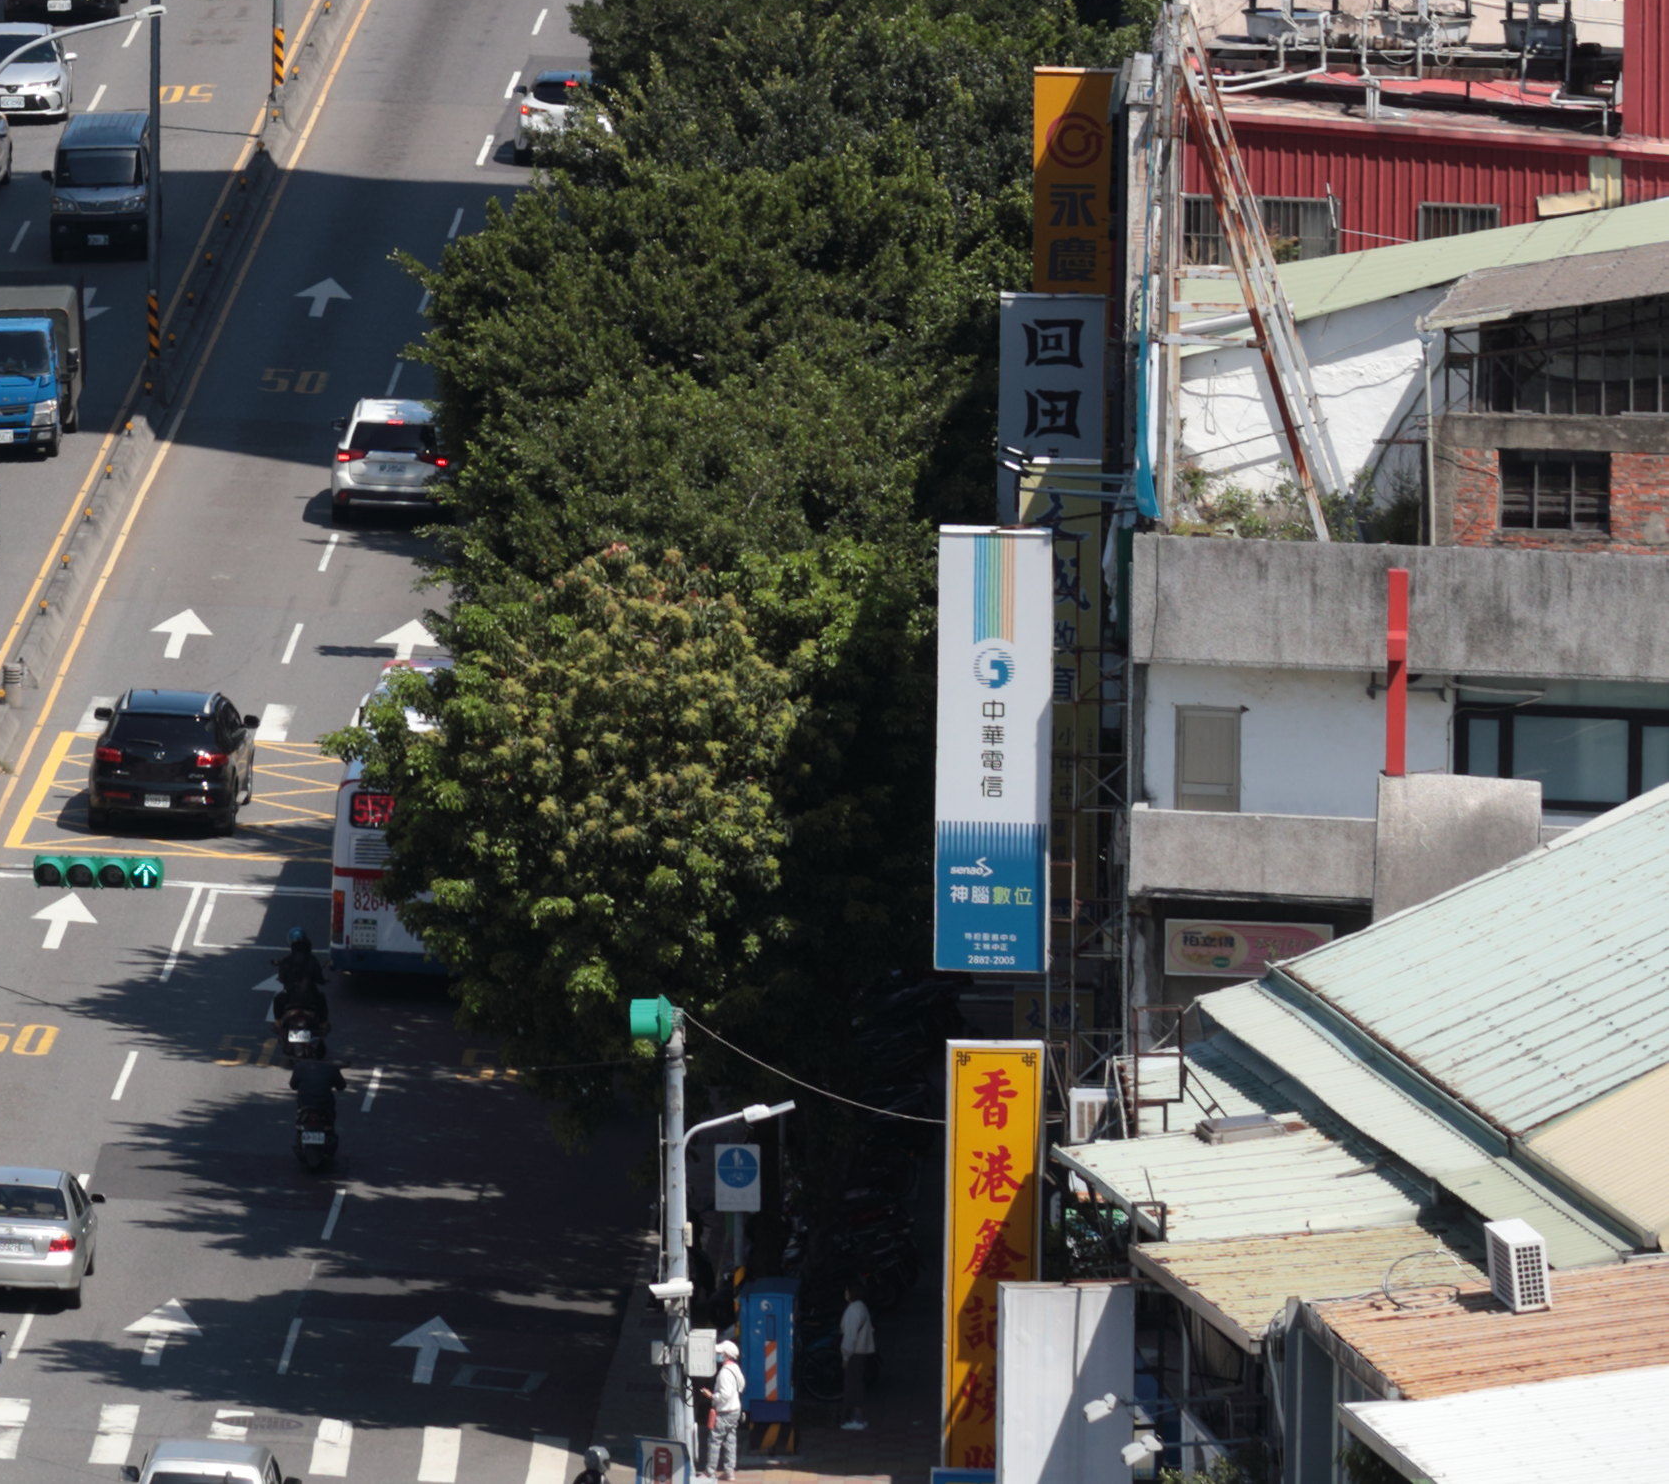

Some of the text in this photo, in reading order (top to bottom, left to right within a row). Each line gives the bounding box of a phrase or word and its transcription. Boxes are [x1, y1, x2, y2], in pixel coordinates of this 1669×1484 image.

[1049, 183, 1097, 282] 永慶
[981, 699, 1006, 800] 中華電信
[949, 886, 1033, 906] 神腦數位
